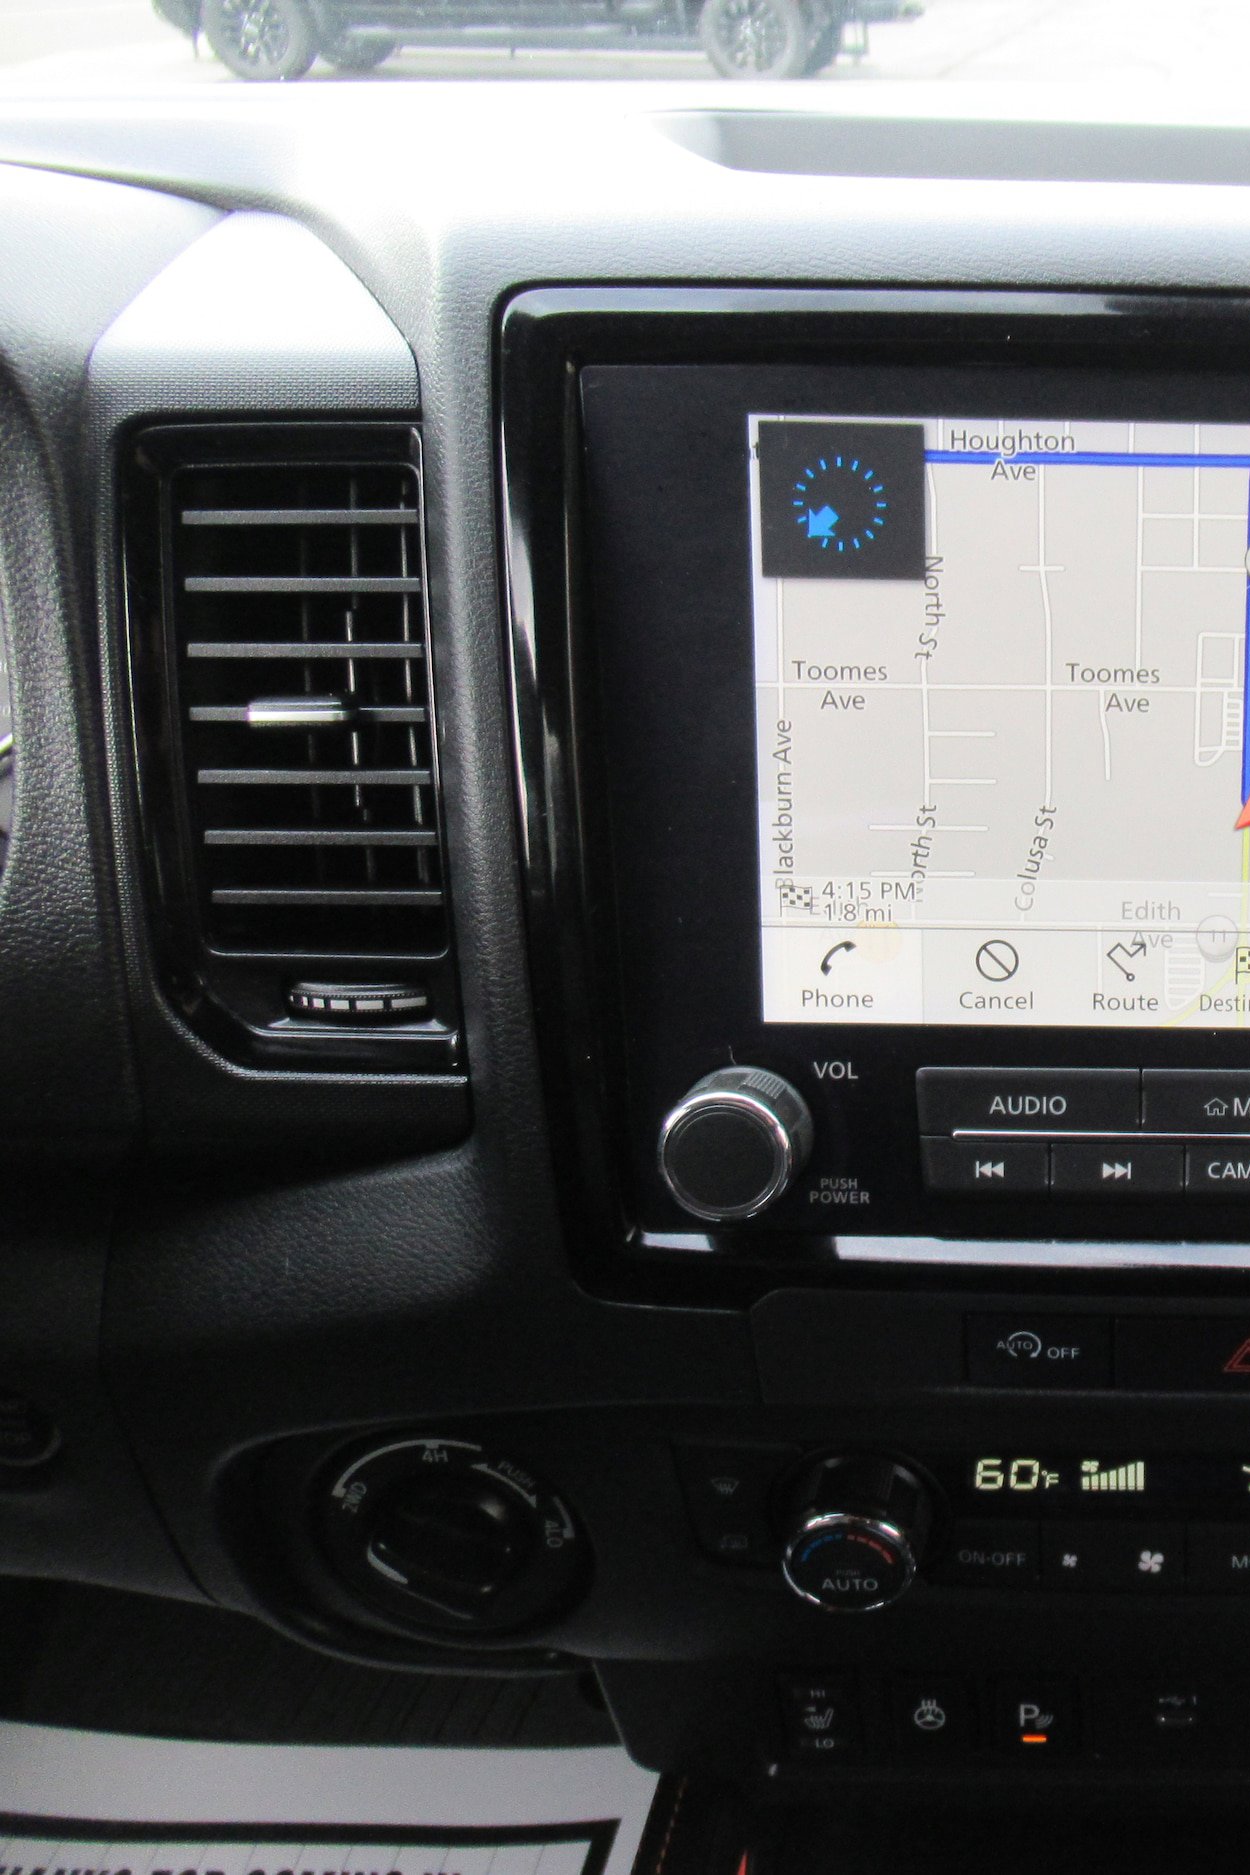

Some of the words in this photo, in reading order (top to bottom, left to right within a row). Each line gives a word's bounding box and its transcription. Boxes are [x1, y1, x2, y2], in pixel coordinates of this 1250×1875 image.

[950, 429, 1076, 457] Houghton
[990, 461, 1037, 482] Ave
[925, 556, 946, 628] North
[914, 631, 938, 660] St
[792, 660, 888, 682] Toomes
[1066, 662, 1160, 684] Toomes
[820, 690, 866, 711] Ave
[1104, 693, 1150, 713] Ave
[772, 719, 793, 765] Ave
[916, 804, 937, 829] St
[772, 773, 794, 889] Blackburn
[910, 835, 933, 902] orth
[1014, 835, 1049, 912] Colusa
[1038, 804, 1057, 829] St
[822, 881, 873, 900] 4:15
[881, 882, 916, 901] PM
[823, 904, 857, 923] 1.8
[865, 904, 893, 923] mi
[1121, 901, 1181, 922] Edith
[1131, 929, 1174, 950] Ave
[801, 989, 874, 1010] Phone
[959, 990, 1034, 1011] Cancel
[1092, 993, 1159, 1012] Route
[814, 1061, 859, 1080] VOL
[989, 1095, 1067, 1116] AUDIO
[820, 1178, 858, 1190] PUSH
[809, 1191, 870, 1204] POWER
[996, 1340, 1033, 1350] AUTO
[1047, 1346, 1081, 1359] OFF
[421, 1449, 449, 1463] 4H
[821, 1577, 879, 1592] AUTO
